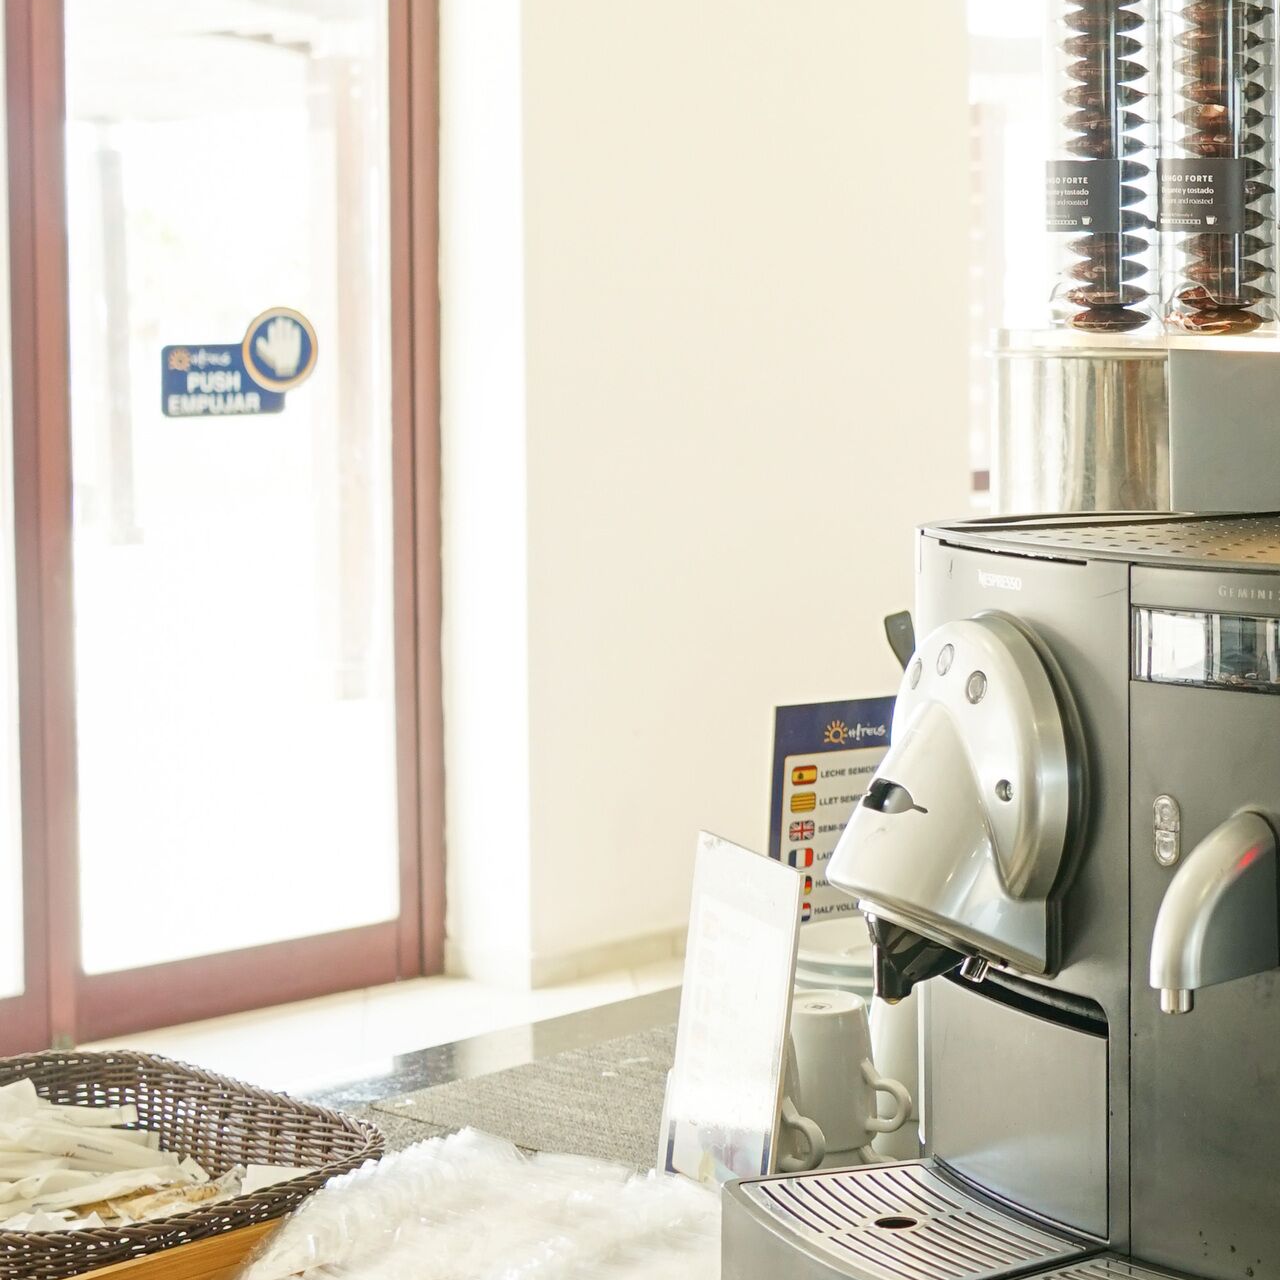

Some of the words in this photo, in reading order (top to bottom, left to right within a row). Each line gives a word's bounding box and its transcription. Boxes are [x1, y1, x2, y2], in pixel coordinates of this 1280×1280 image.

[1063, 176, 1089, 184] FORTE
[1185, 174, 1214, 182] FORTE
[1064, 188, 1090, 196] tostado
[187, 371, 241, 393] PUSH
[168, 392, 260, 415] EMPUJAR
[1218, 585, 1273, 600] GEMINI
[821, 767, 846, 778] LECHE
[819, 796, 838, 805] LLET
[814, 906, 834, 915] HALF
